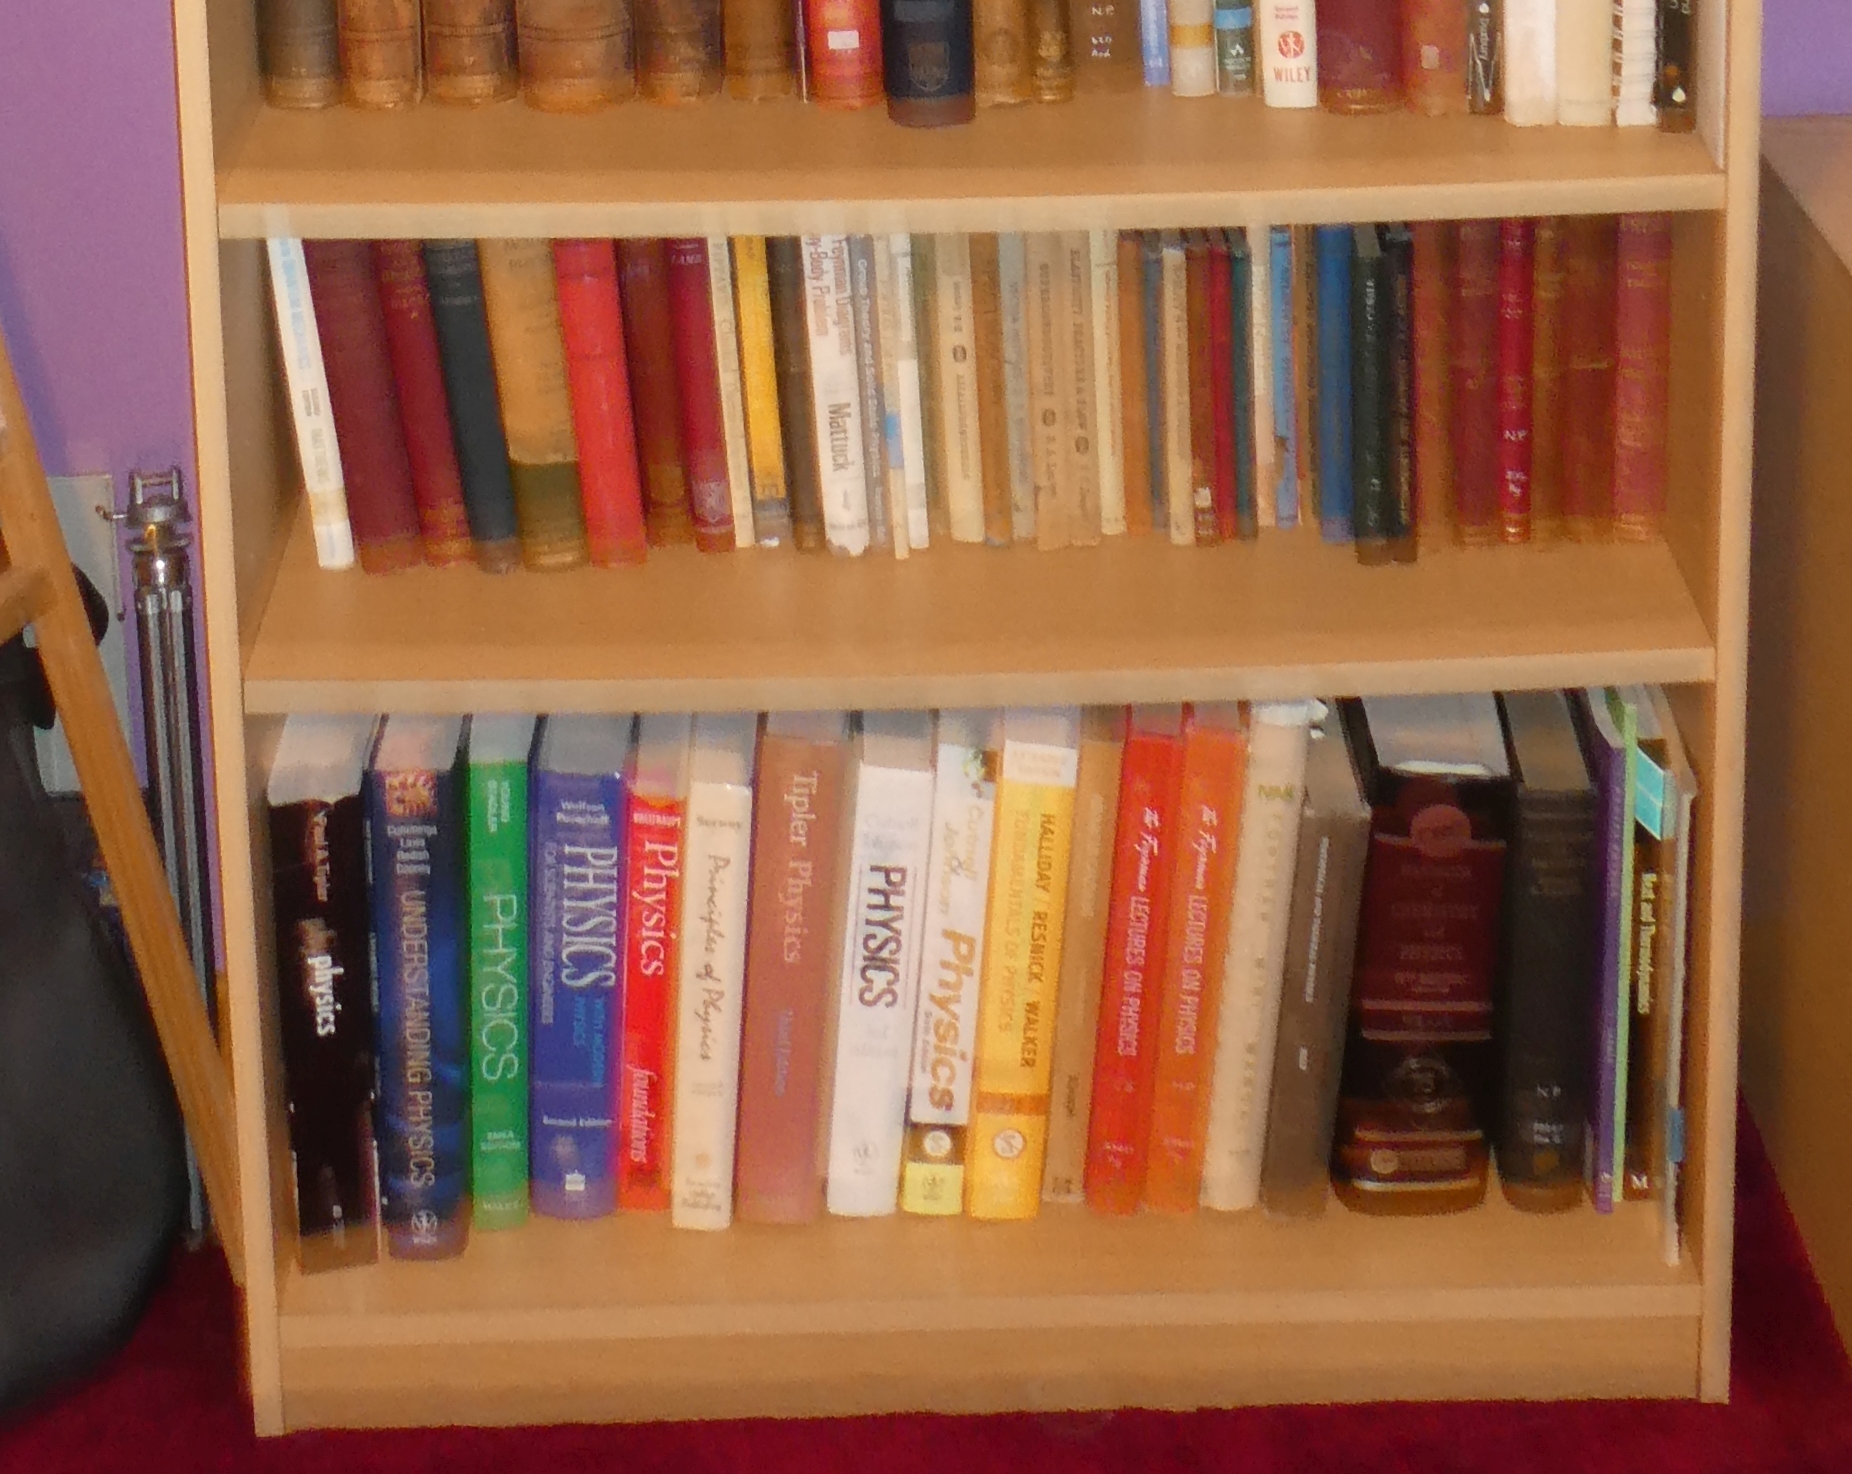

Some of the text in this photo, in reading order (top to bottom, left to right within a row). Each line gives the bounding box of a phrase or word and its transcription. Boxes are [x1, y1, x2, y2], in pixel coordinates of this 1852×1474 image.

[1273, 65, 1311, 84] WILEY
[827, 402, 854, 473] Mattuck
[562, 845, 618, 989] PHYSICS
[631, 840, 679, 978] Physics
[782, 772, 819, 964] Tipler Physics
[859, 865, 908, 1009] PHYSICS
[1019, 813, 1056, 1069] HALLIDAY RESNICK WALKER
[307, 955, 343, 1037] physics
[481, 894, 519, 1082] PHYSICS
[697, 854, 730, 1061] Principles Physics
[928, 929, 977, 1113] Physics
[1117, 896, 1150, 1057] LECTURES ON PHYSICS
[1175, 895, 1208, 1056] LECTURES ON PHYSICS
[401, 890, 436, 1188] UNDERSTANDING PHYSICS
[627, 1064, 656, 1163] foundations
